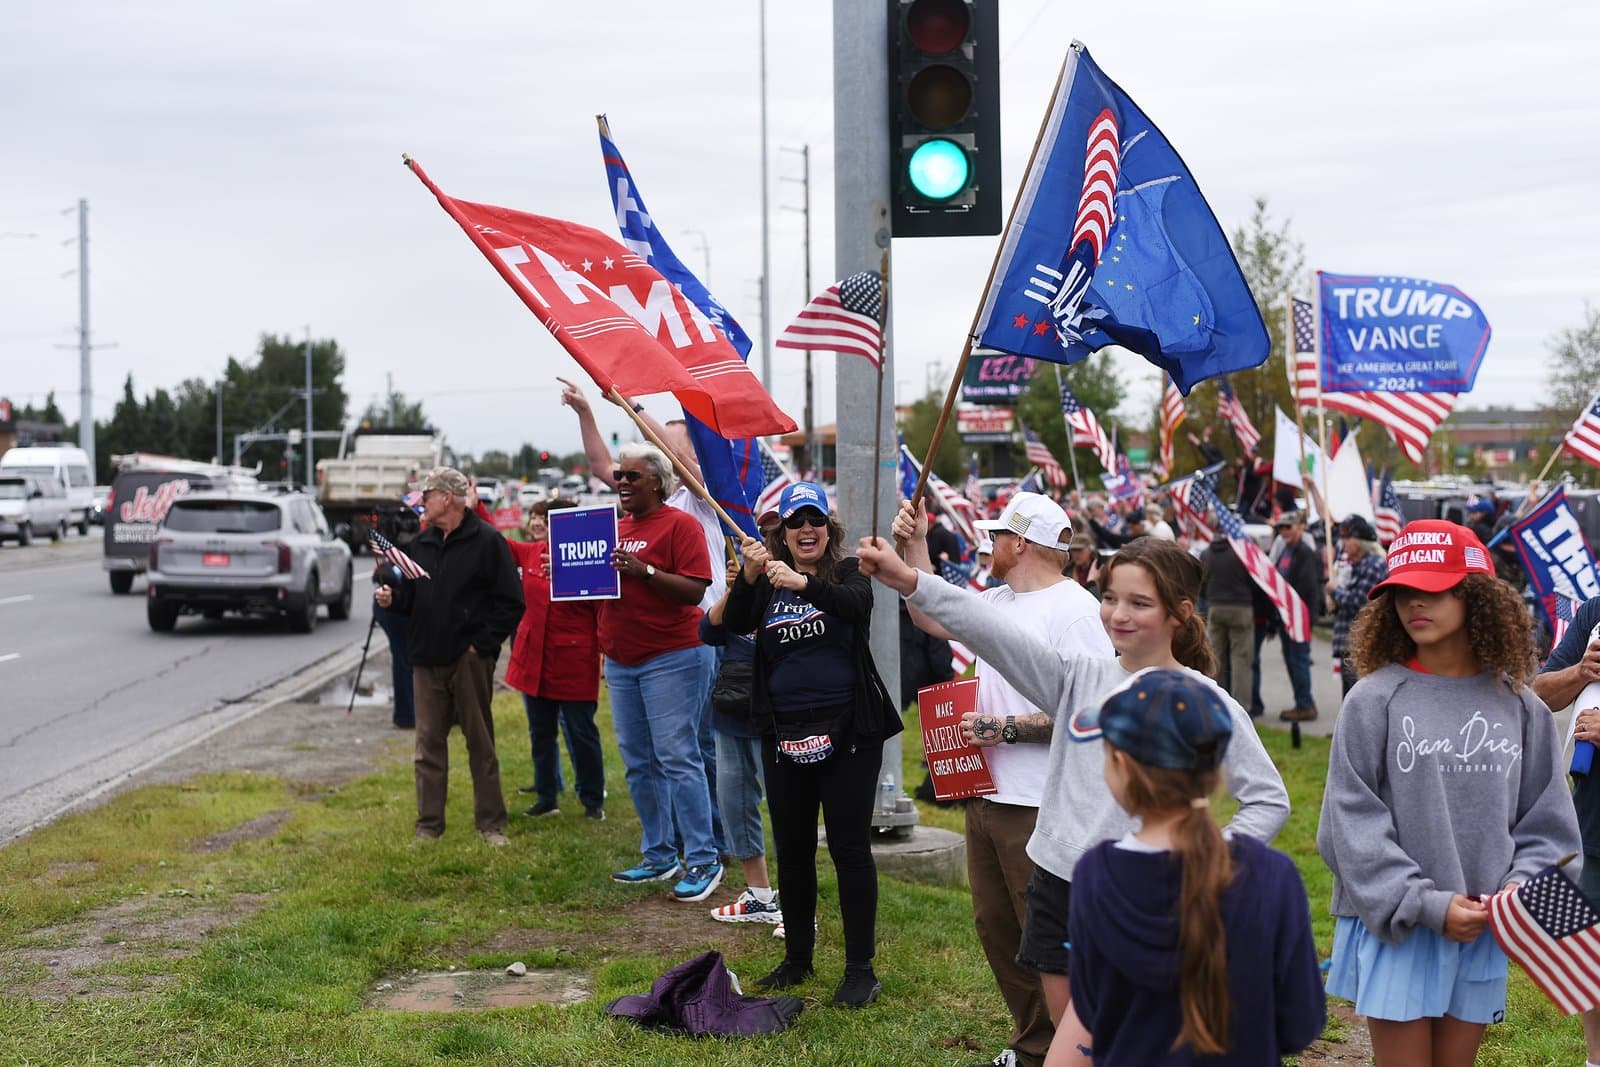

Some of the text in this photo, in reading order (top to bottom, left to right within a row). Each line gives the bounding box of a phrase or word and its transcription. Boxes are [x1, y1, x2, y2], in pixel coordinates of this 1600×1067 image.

[1333, 287, 1472, 320] TRUMP
[1347, 324, 1443, 352] VANCE
[1355, 361, 1404, 374] AMERICA
[1376, 377, 1416, 391] 2024
[1403, 532, 1453, 546] AMERICA
[558, 540, 607, 561] TRUMP
[1408, 549, 1446, 563] AGAIN
[772, 600, 813, 614] Tru
[777, 619, 826, 644] 2020
[935, 701, 954, 719] MAKE
[784, 735, 828, 752] TRUMP
[925, 725, 968, 754] AMERIC
[1396, 710, 1523, 779] San Dieg
[791, 751, 827, 764] 2020
[933, 754, 983, 777] GREAT AGAIN
